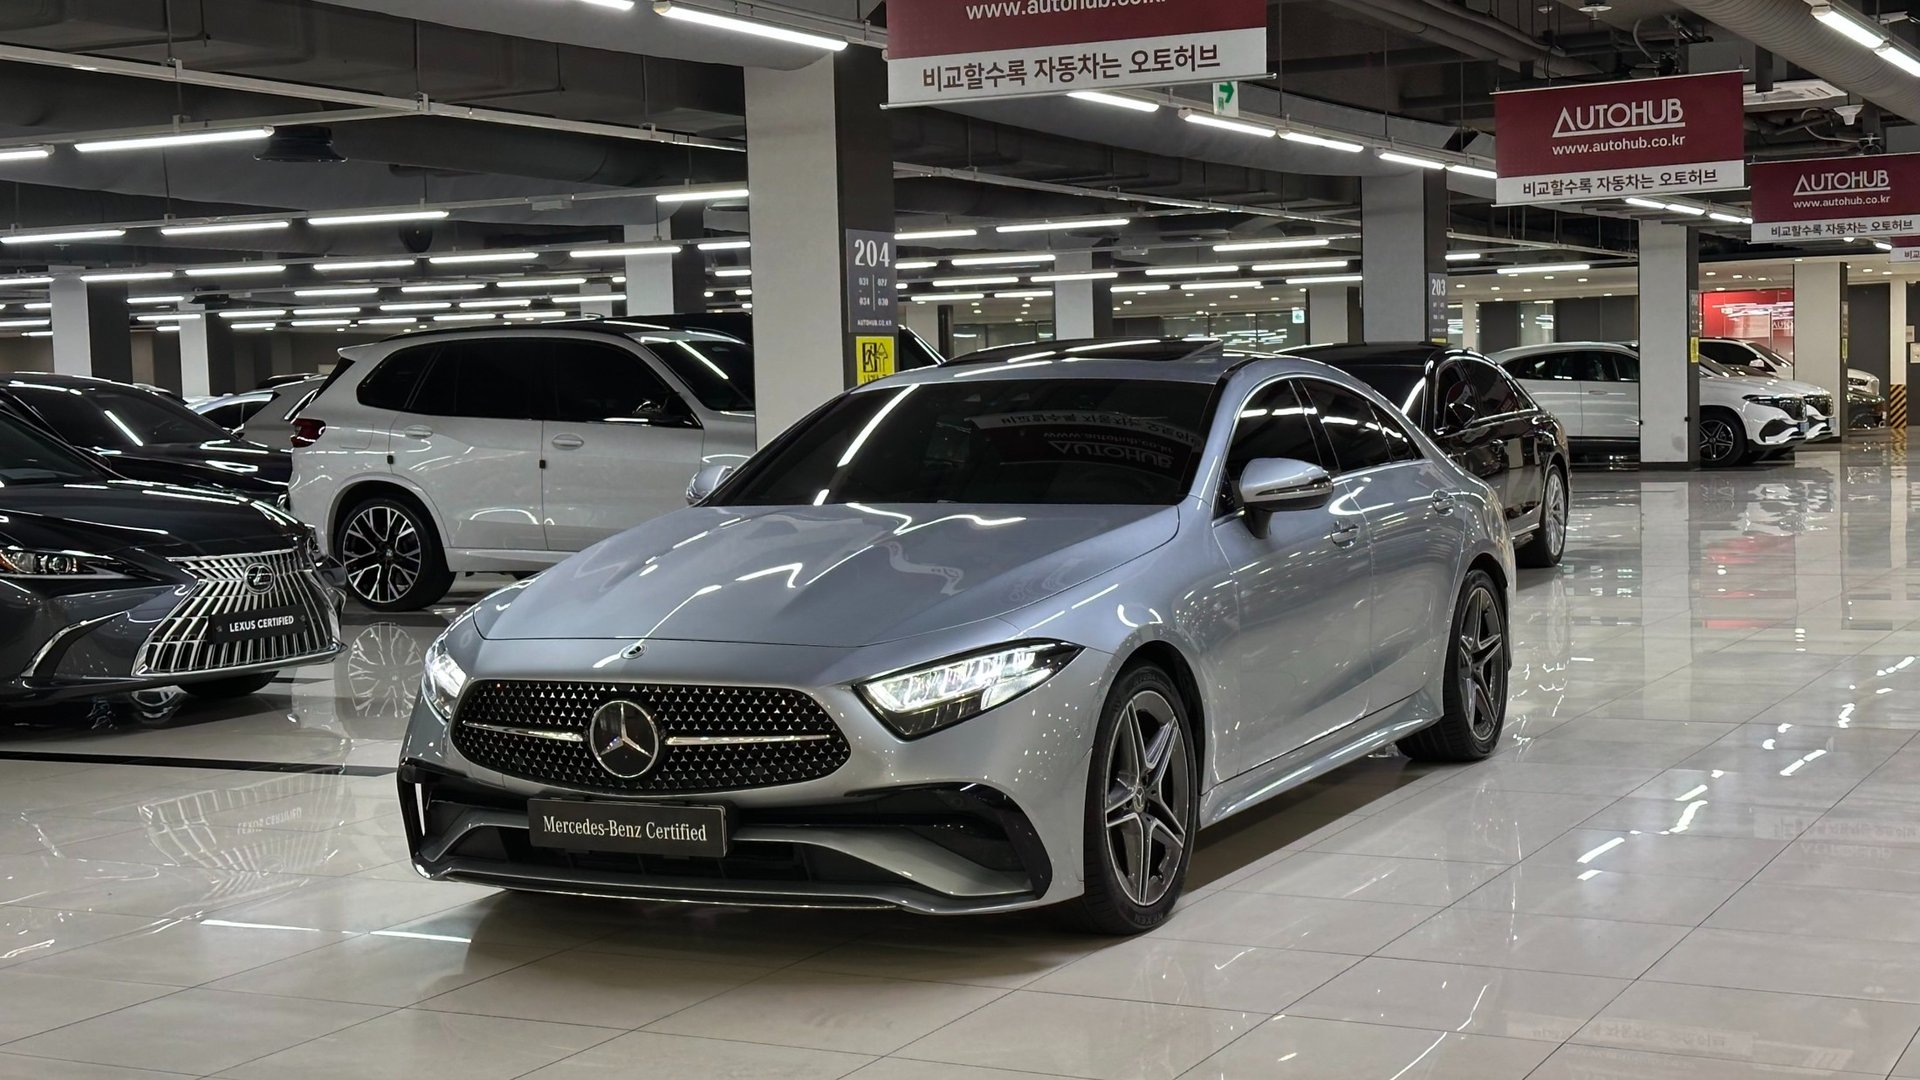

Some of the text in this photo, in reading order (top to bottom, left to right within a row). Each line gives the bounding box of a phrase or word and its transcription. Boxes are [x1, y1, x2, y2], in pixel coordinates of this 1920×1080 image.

[923, 44, 1221, 92] 비교할수록 자동차는 오토허브
[1552, 98, 1686, 138] AUTOHUB
[1552, 134, 1686, 155] www.autohub.co.kr
[1523, 168, 1718, 197] 비교할수록 자동차는 오토허브
[1793, 169, 1890, 196] AUTOHUB
[1793, 194, 1891, 209] www.autohub.co.kr
[1771, 219, 1914, 238] 비교할수록 자동차는 오토허브
[854, 239, 890, 268] 204
[1431, 278, 1446, 296] 203
[229, 615, 294, 633] LEXUS CERTIFIED
[543, 815, 708, 842] Mercedes-Benz Certified
